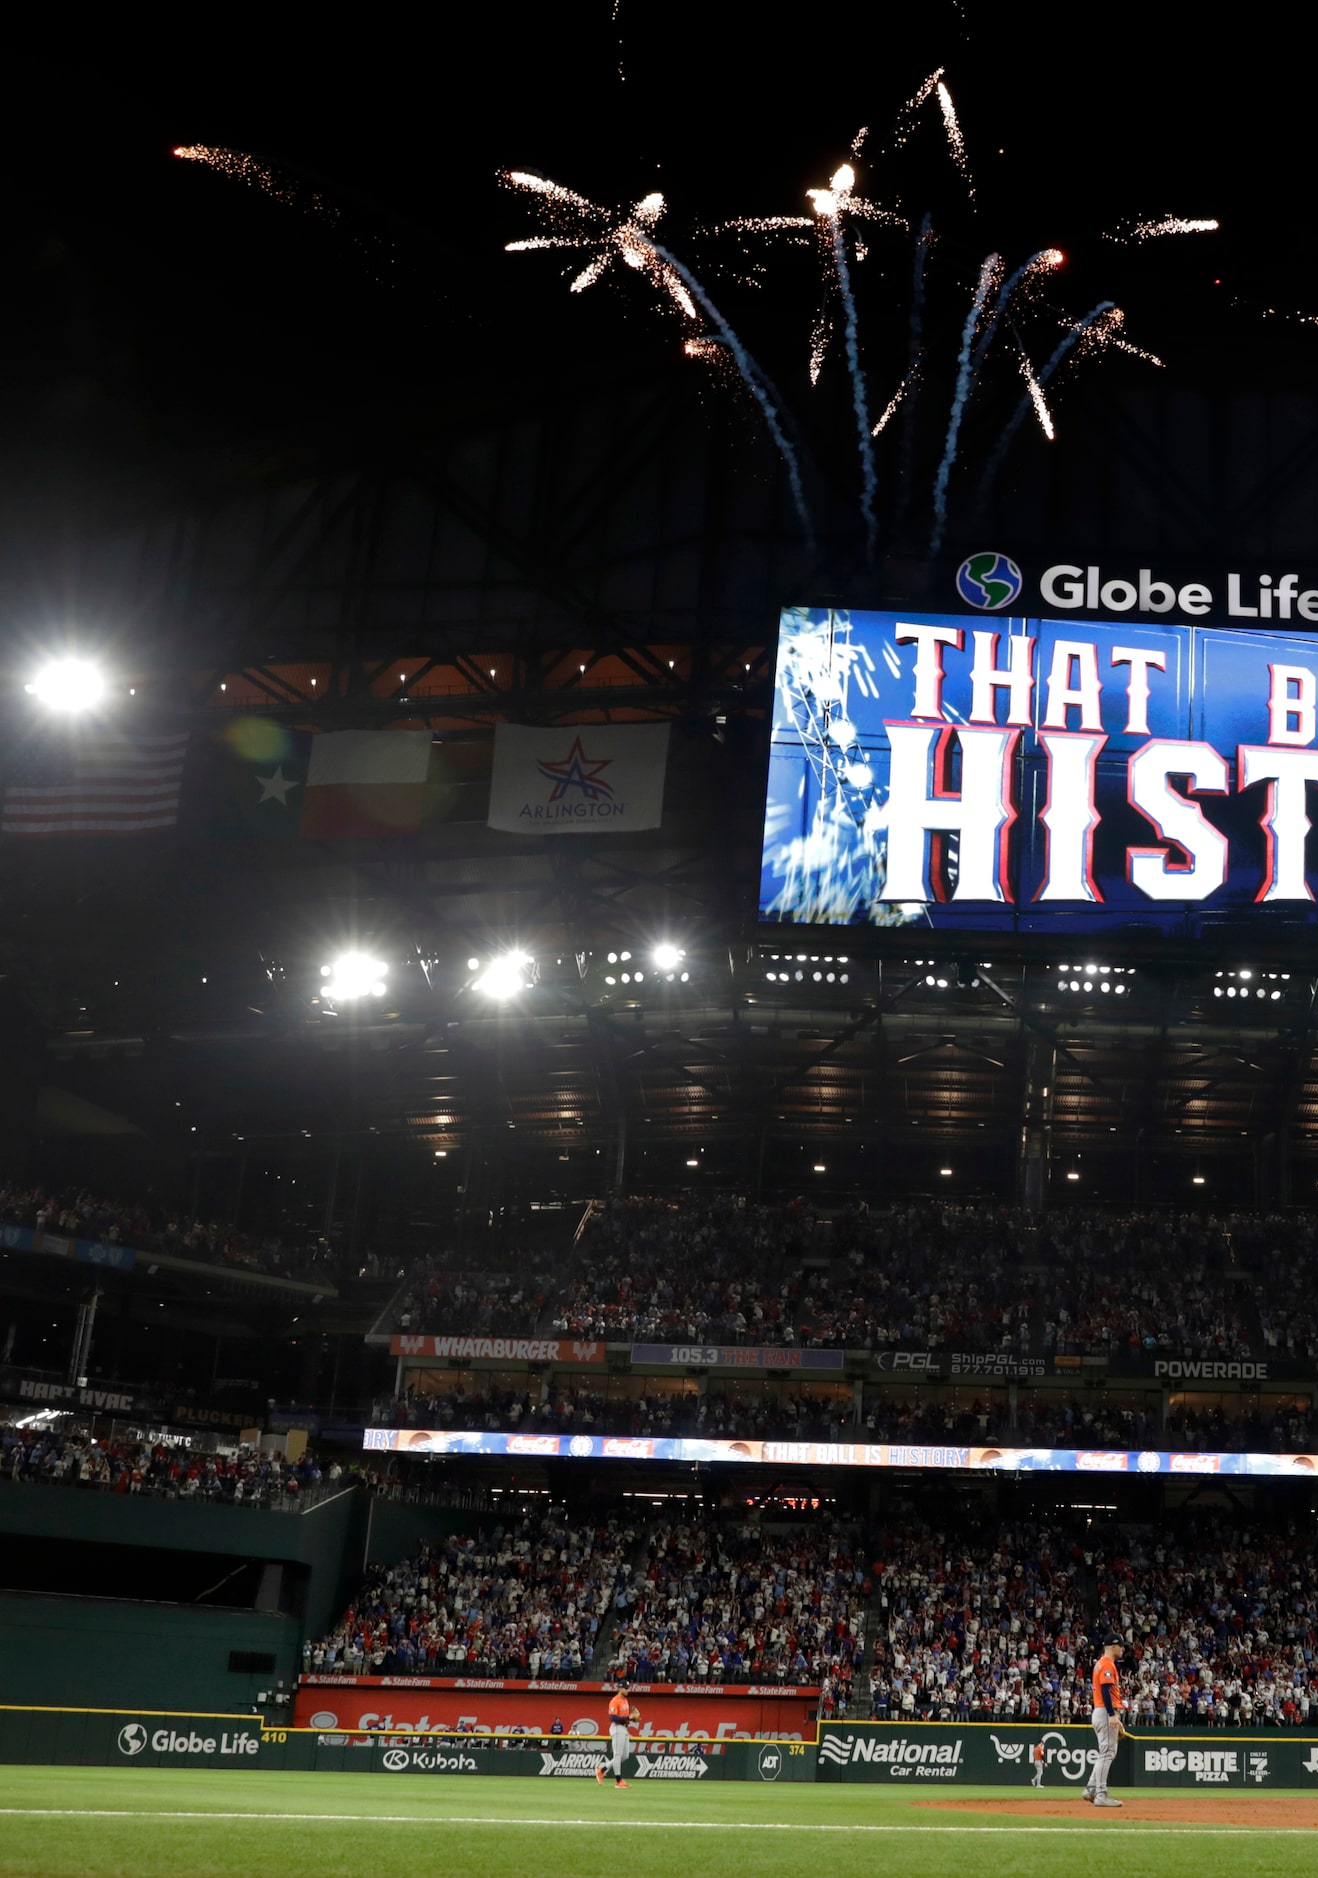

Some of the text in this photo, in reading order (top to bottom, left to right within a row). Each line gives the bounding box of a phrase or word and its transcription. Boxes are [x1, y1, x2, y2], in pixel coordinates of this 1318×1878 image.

[1039, 564, 1213, 616] Globe
[894, 622, 1166, 735] THAT
[519, 803, 624, 818] ARLINGTON
[434, 1336, 560, 1360] WHATABURGER
[670, 1347, 802, 1367] 105.3 THE FAN
[893, 1352, 940, 1369] PGL
[951, 1353, 1046, 1366] ShipPGL.com
[951, 1365, 1046, 1376] 877.701.1919
[1155, 1360, 1268, 1380] POWERADE
[80, 1389, 134, 1411] HVAC
[766, 1443, 810, 1463] THAT
[816, 1444, 858, 1464] BALL
[864, 1446, 882, 1464] IS
[888, 1447, 969, 1466] HISTORY
[318, 1676, 357, 1685] StateFarm
[392, 1677, 431, 1686] StateFarm
[466, 1679, 504, 1688] StateFarm
[539, 1681, 578, 1690] StateFarm
[686, 1685, 724, 1694] StateFarm
[759, 1687, 797, 1695] StateFarm
[152, 1729, 259, 1755] Globe Life
[261, 1732, 287, 1743] 410
[788, 1744, 805, 1756] 374
[851, 1734, 960, 1764] National
[412, 1752, 476, 1770] Kubota
[653, 1756, 697, 1771] ARROW
[763, 1755, 779, 1769] ADT
[1188, 1751, 1238, 1772] BITE
[890, 1765, 957, 1777] Car Rental
[1196, 1772, 1229, 1782] PIZZA
